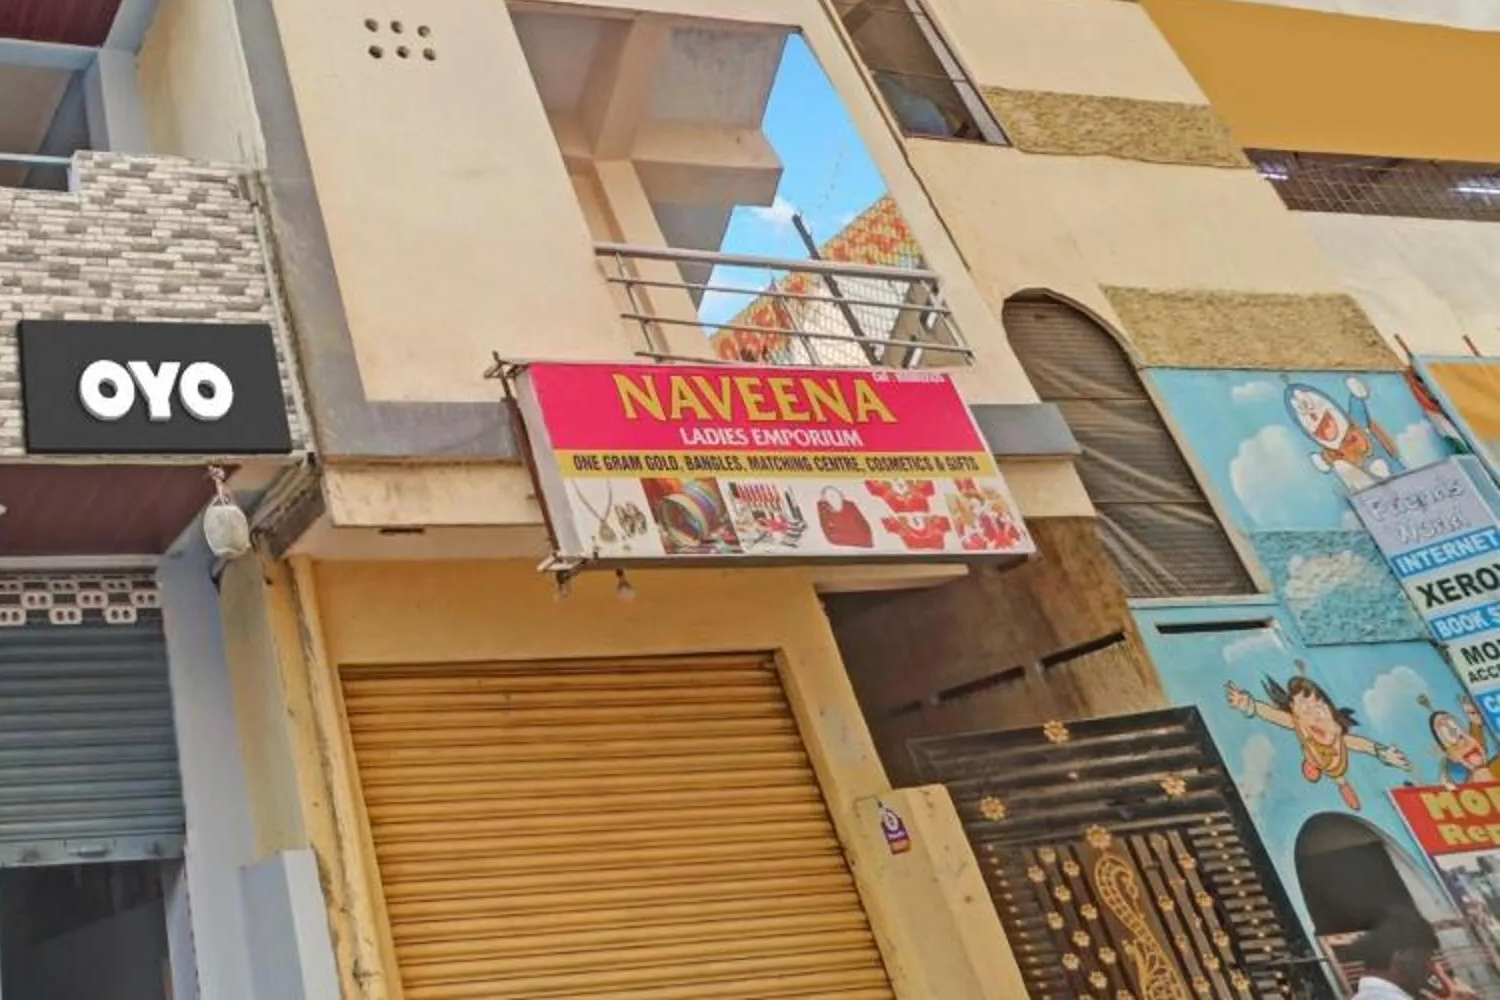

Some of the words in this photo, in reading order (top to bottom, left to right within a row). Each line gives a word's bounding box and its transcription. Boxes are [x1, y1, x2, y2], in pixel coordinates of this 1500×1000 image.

[79, 359, 234, 422] OYO
[612, 373, 900, 423] NAVEENA
[679, 427, 749, 446] LADIES
[752, 428, 864, 448] EMPORIUM
[573, 454, 600, 471] ONE
[603, 455, 643, 471] GRAM
[747, 456, 812, 472] MATCHING
[865, 456, 933, 472] COSMETICS
[934, 457, 946, 472] &
[946, 457, 979, 472] GIFTS
[1395, 528, 1500, 575] INTERNET
[1434, 608, 1491, 638] BOOK
[1460, 639, 1500, 666] MO
[1468, 664, 1500, 683] ACC
